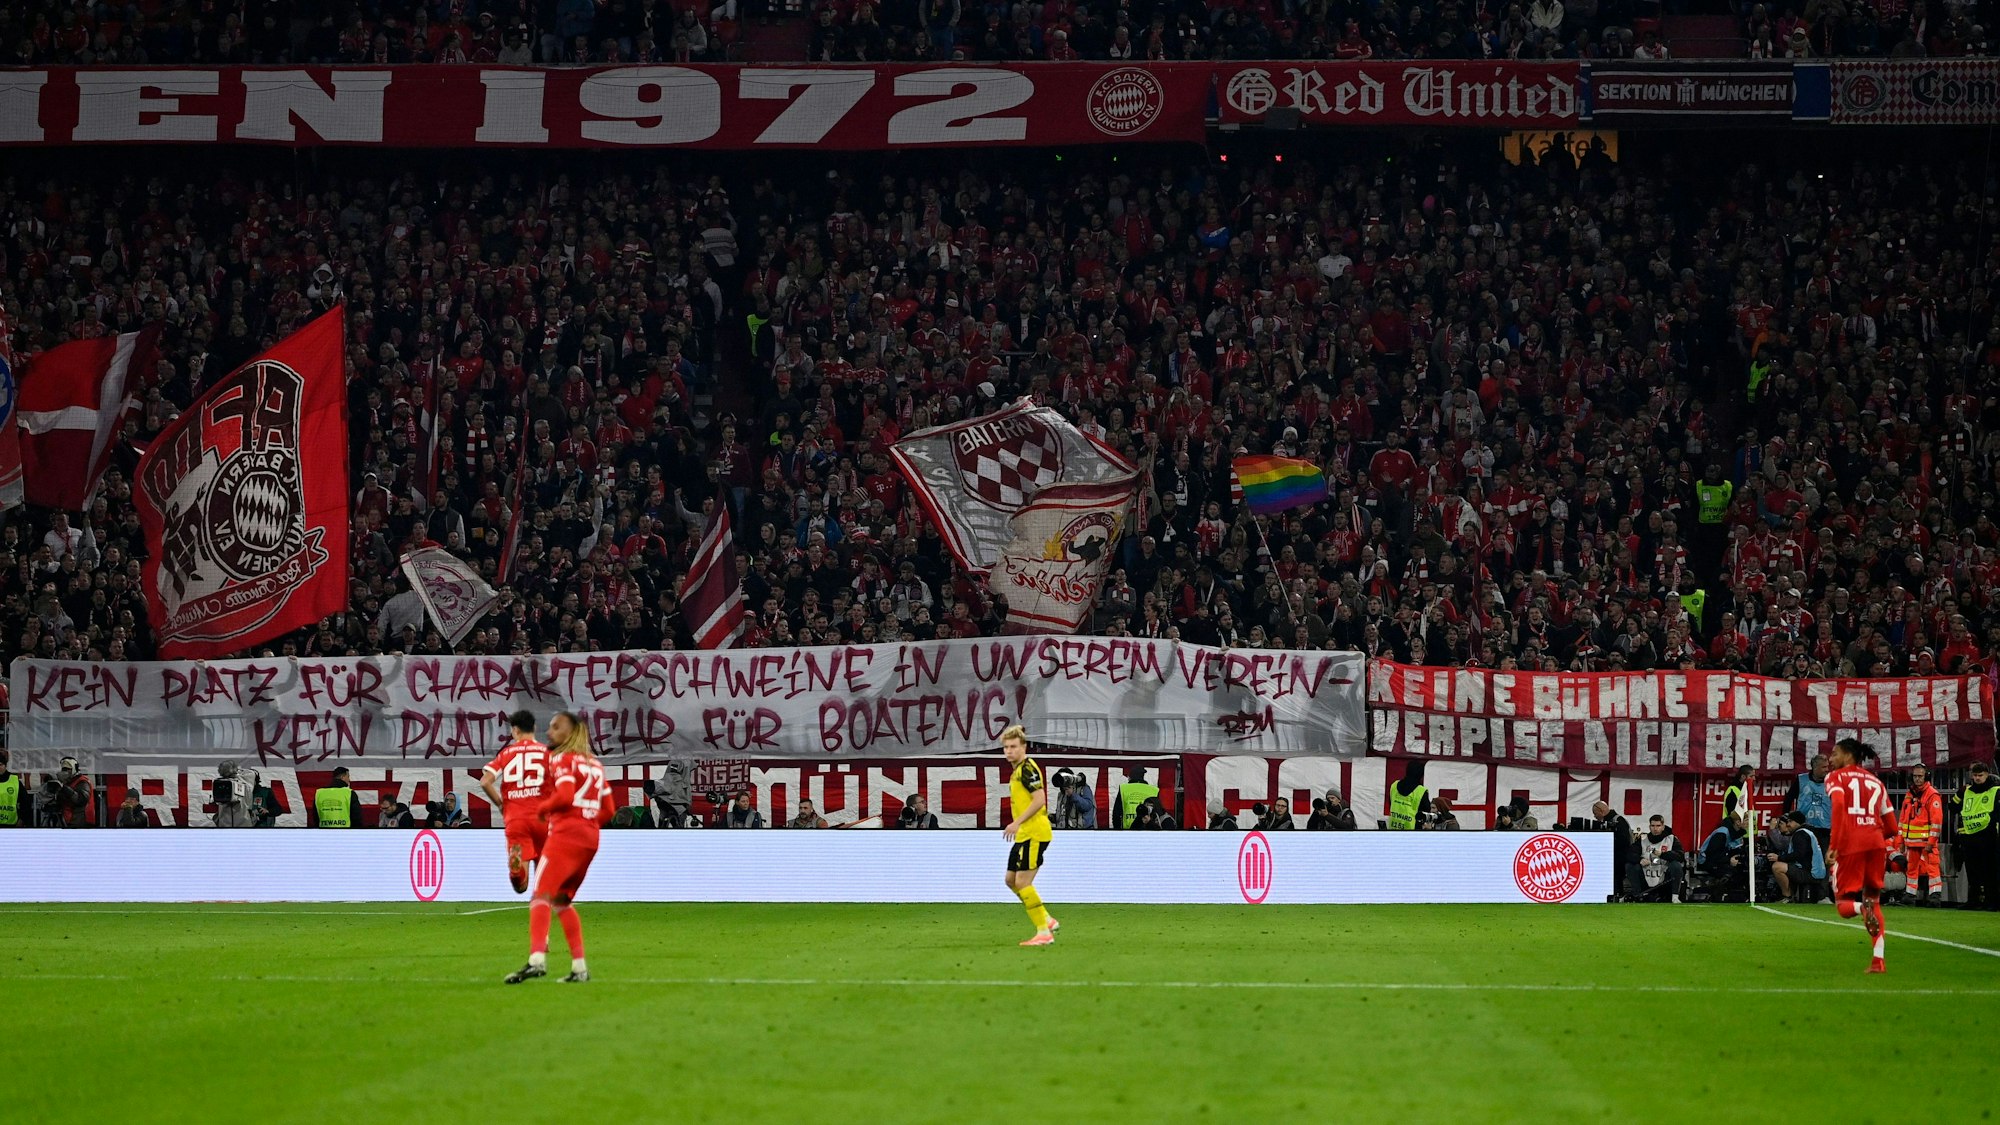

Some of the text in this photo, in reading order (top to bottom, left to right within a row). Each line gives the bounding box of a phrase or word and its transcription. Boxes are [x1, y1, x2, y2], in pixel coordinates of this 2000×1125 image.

[1114, 73, 1157, 96] BAYERN
[1282, 67, 1386, 115] Red
[1401, 66, 1575, 118] United
[1598, 79, 1788, 102] SEKTION MÜNCHEN
[475, 67, 1035, 145] 1972
[1093, 105, 1140, 130] MÜNCHEN
[1519, 131, 1608, 162] Kafe
[160, 663, 279, 710] PLATZ
[298, 659, 389, 711] FÜR
[971, 637, 1165, 684] UNSEREM
[1369, 663, 1516, 717] KEINE
[1706, 674, 1793, 720] FÜR
[1807, 676, 1983, 724] TÄTER!
[702, 707, 783, 750] FÜR
[818, 685, 1028, 752] BOATENG!
[1217, 704, 1275, 739] RFM
[1372, 709, 1565, 764] VERPISS
[1583, 720, 1690, 766] DICH
[503, 752, 545, 788] 45
[715, 784, 736, 792] STOP
[1705, 779, 1725, 796] FC
[1847, 777, 1882, 815] 17
[320, 819, 347, 827] TEWARD
[1390, 811, 1413, 822] TEWARD
[1519, 839, 1578, 865] FC BAYERN
